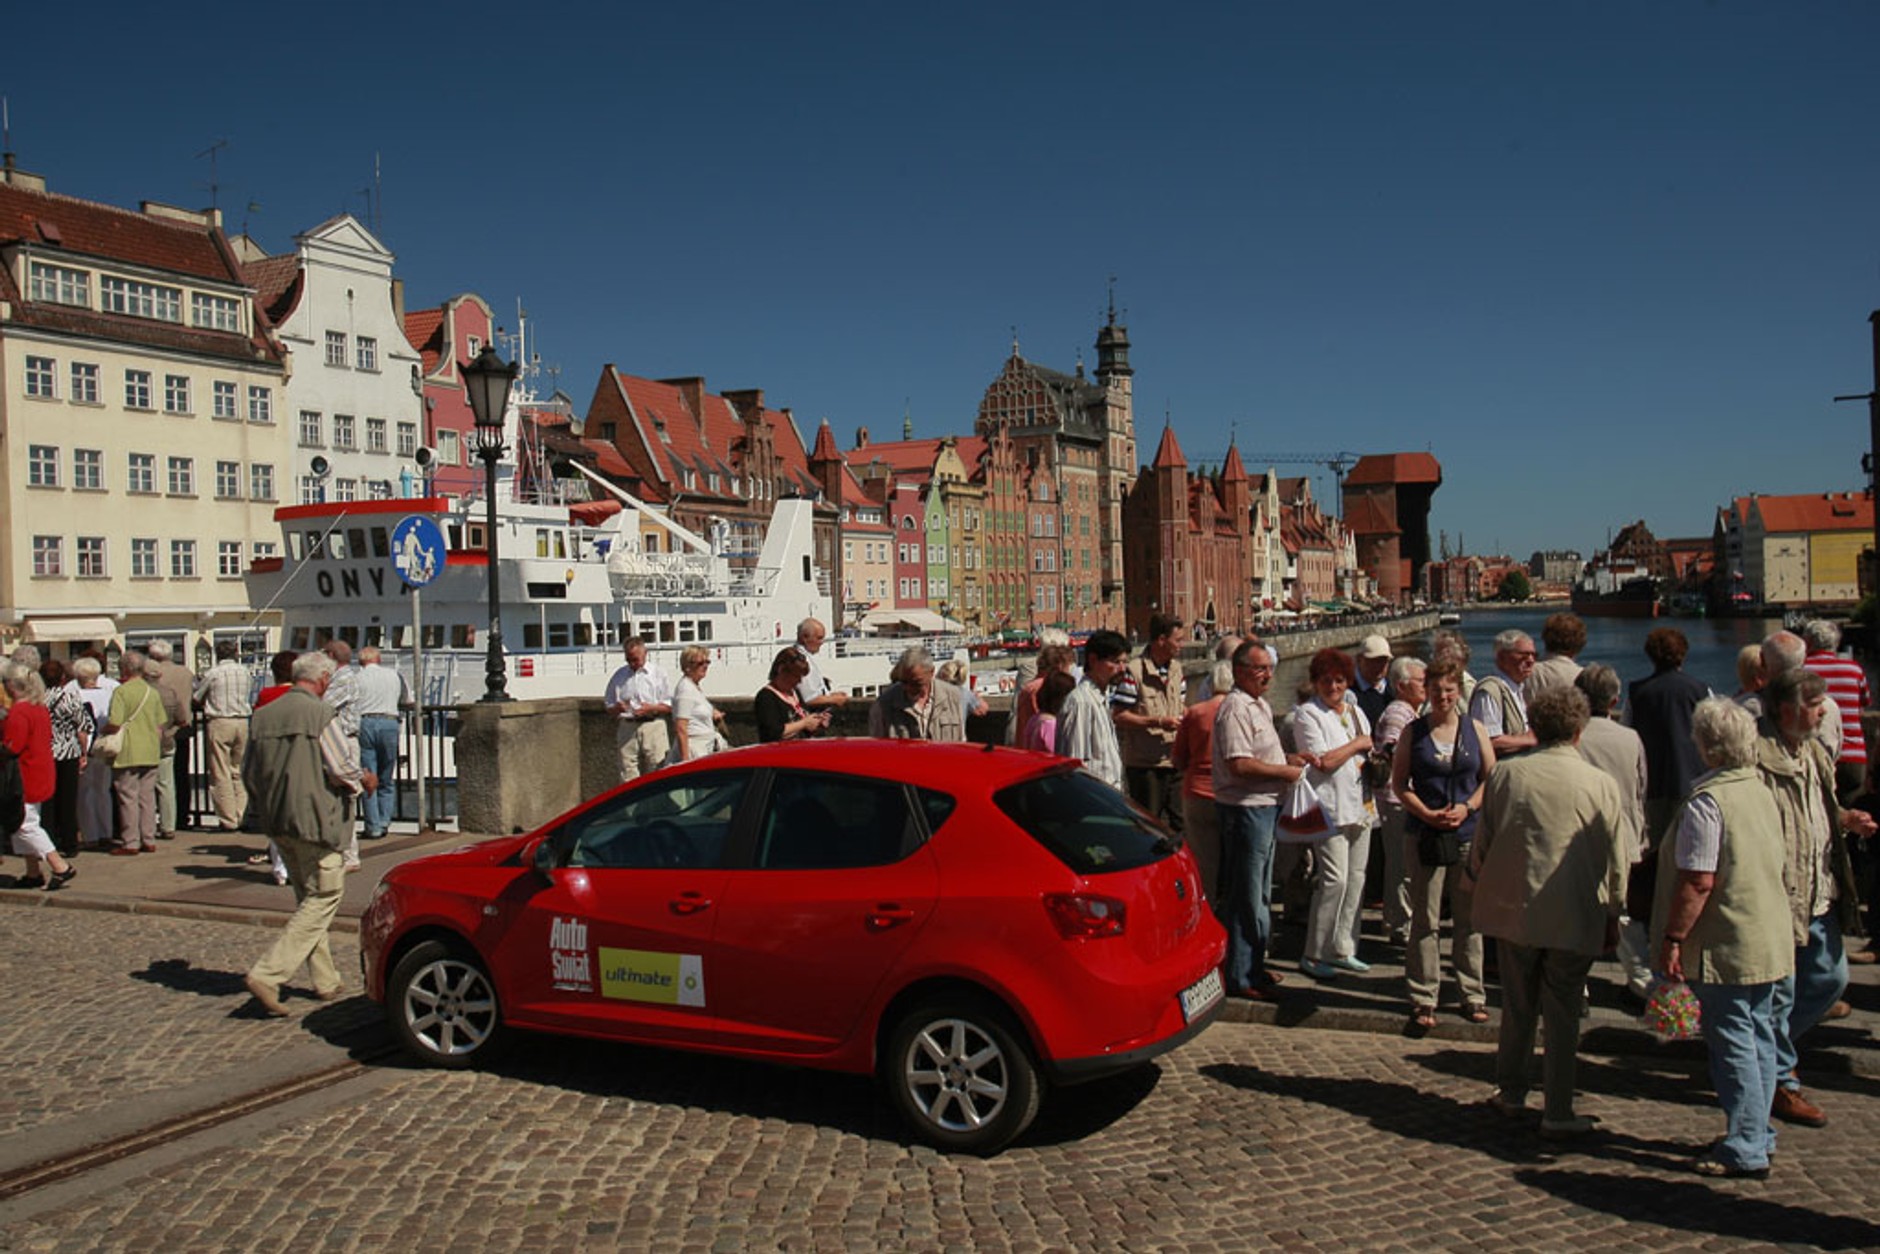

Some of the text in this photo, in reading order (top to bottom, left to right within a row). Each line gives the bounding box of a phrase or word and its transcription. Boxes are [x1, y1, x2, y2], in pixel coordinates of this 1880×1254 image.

[317, 567, 414, 597] ONY
[550, 917, 587, 950] Auto
[605, 968, 672, 987] ultimate
